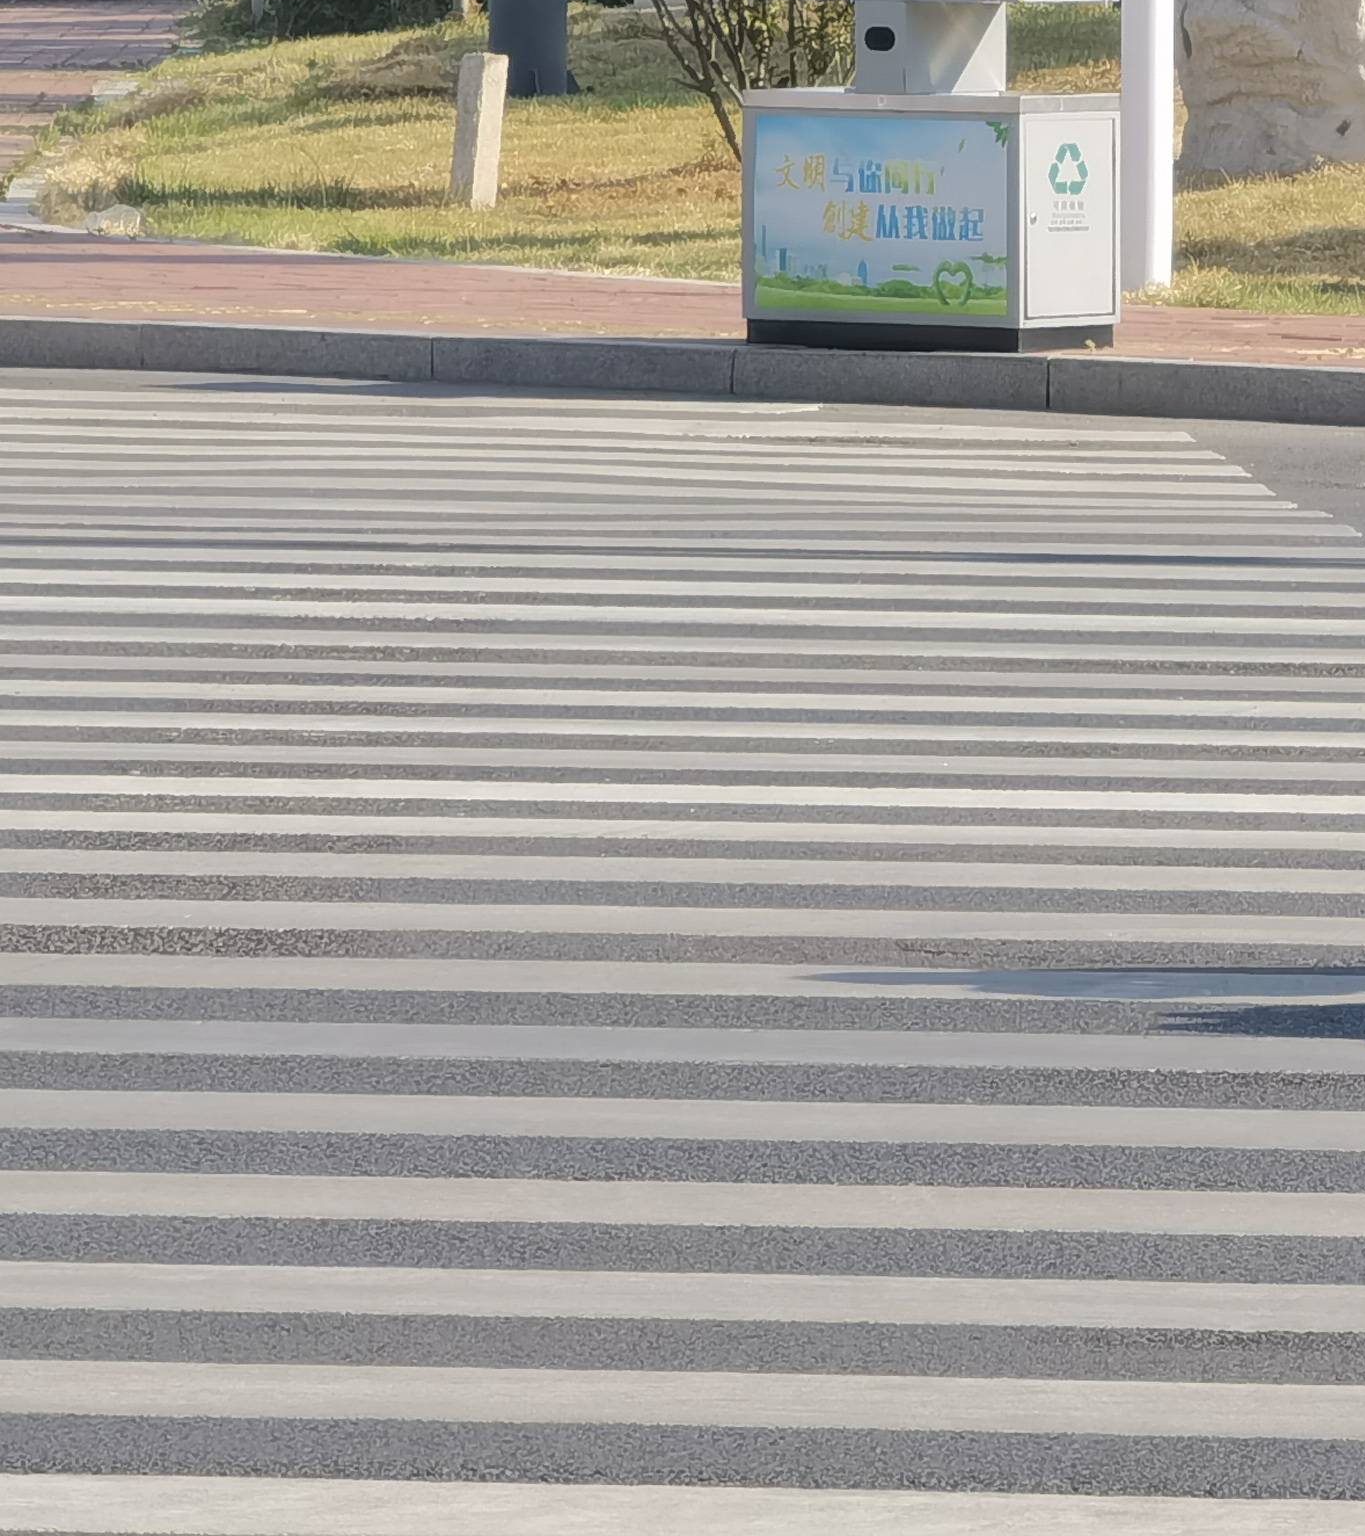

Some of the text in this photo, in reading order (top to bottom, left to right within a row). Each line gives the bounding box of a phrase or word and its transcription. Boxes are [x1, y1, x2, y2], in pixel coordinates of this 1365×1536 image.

[823, 200, 984, 242] 创建从我做起
